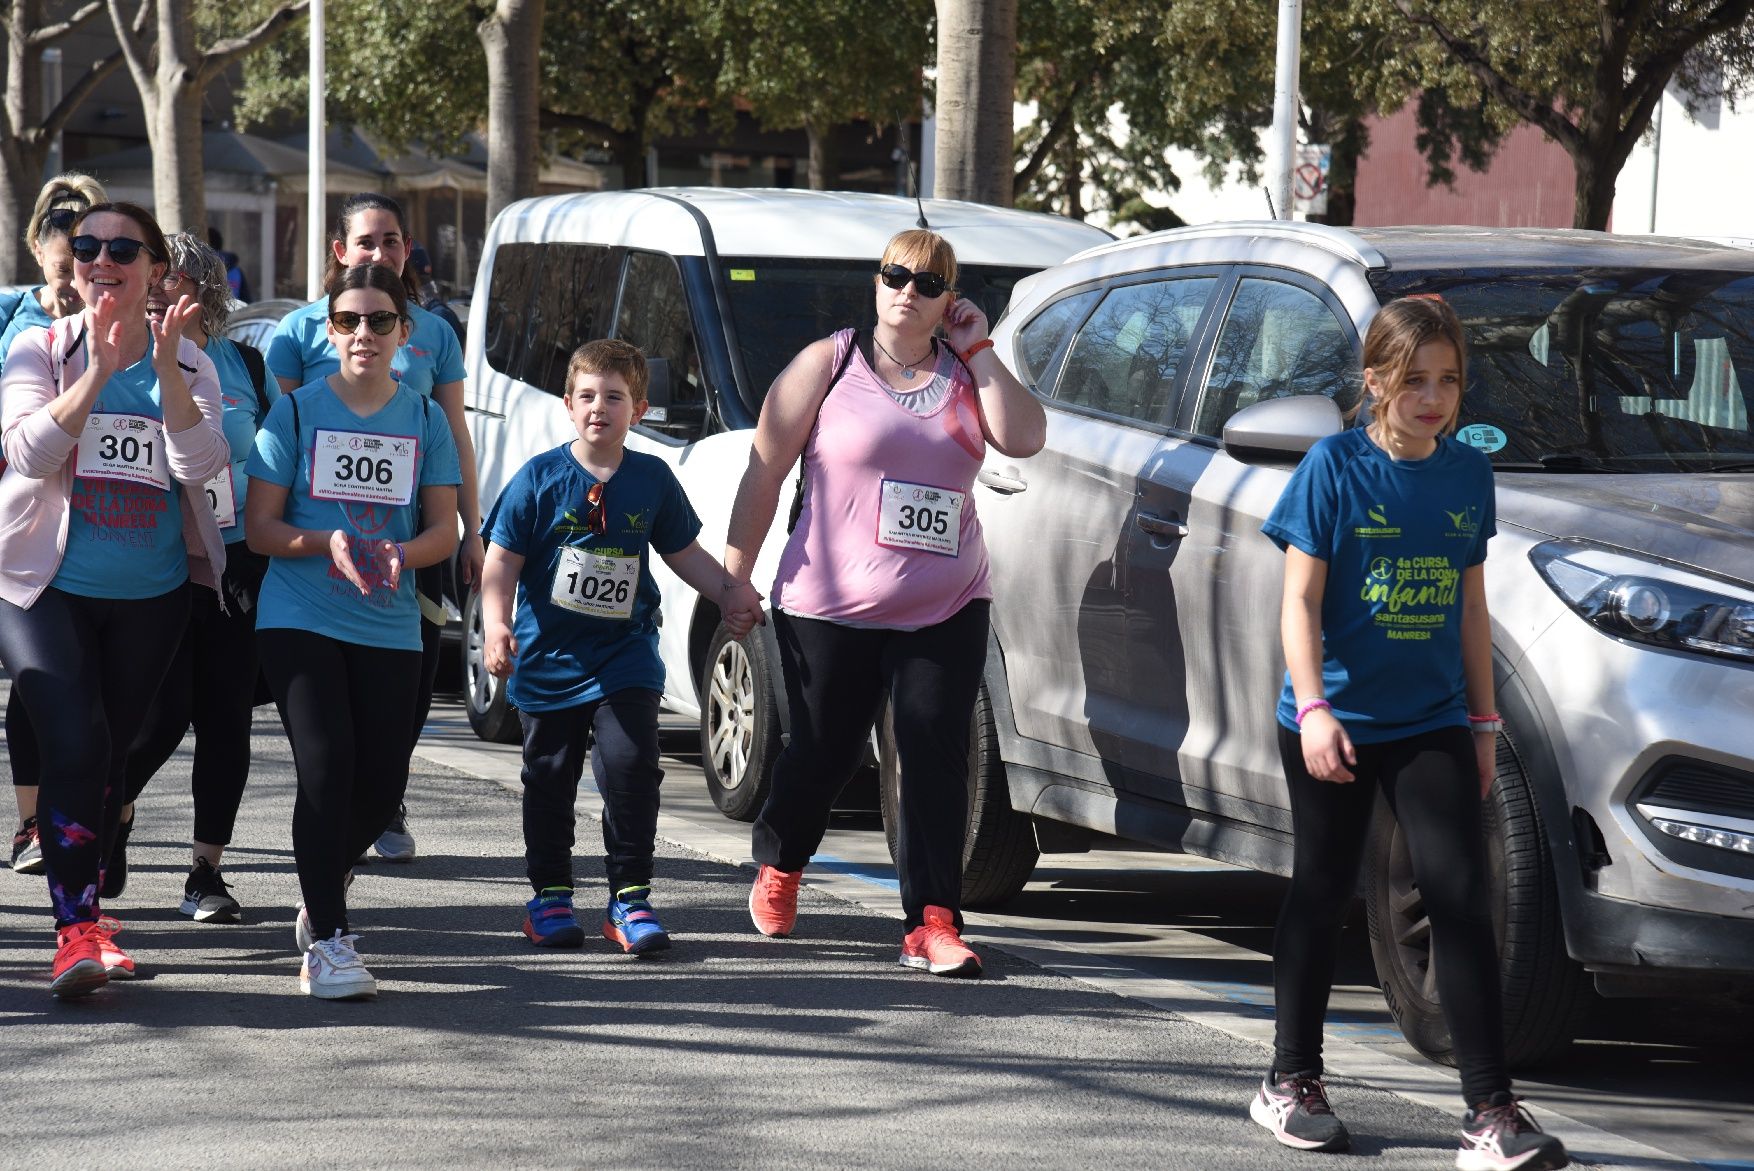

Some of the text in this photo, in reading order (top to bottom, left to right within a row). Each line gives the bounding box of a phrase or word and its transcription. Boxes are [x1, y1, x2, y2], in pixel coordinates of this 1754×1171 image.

[99, 434, 153, 466] 301
[335, 454, 393, 485] 306
[73, 493, 168, 513] DE LA DONA
[82, 511, 158, 529] MANRESA
[898, 504, 949, 535] 305
[593, 547, 624, 556] CURSA
[1396, 556, 1449, 569] 4a CURSA
[1396, 568, 1459, 580] DE LA DONA
[567, 571, 630, 604] 1026
[1360, 571, 1460, 613] infantil
[1374, 612, 1446, 624] santasusana
[1386, 629, 1431, 640] MANRESA
